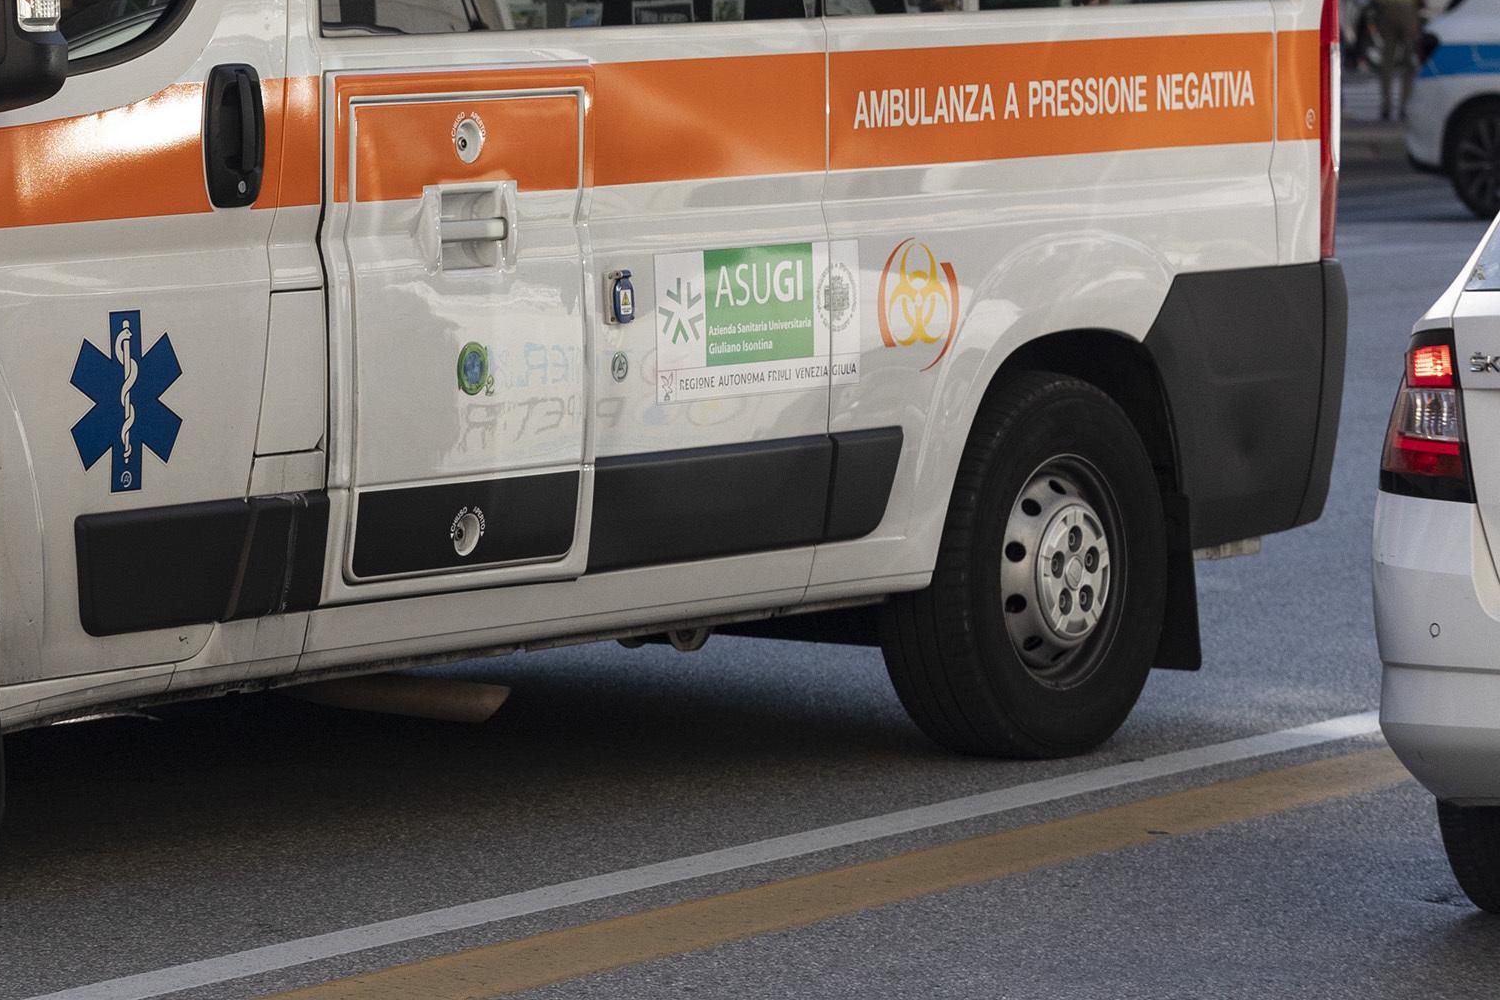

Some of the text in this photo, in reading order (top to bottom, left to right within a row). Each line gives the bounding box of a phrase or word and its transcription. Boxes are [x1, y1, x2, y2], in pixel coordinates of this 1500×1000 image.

[853, 70, 1255, 129] AMBULANZA A PRESSIONE NEGATIVA
[714, 259, 804, 308] ASUGI
[708, 317, 812, 337] Azienda Sanitaria Universitaria
[708, 338, 773, 355] Giuliano Isontina
[679, 374, 716, 391] REGIONE
[718, 371, 765, 388] AUTONOMA
[768, 367, 792, 383] FRIULI
